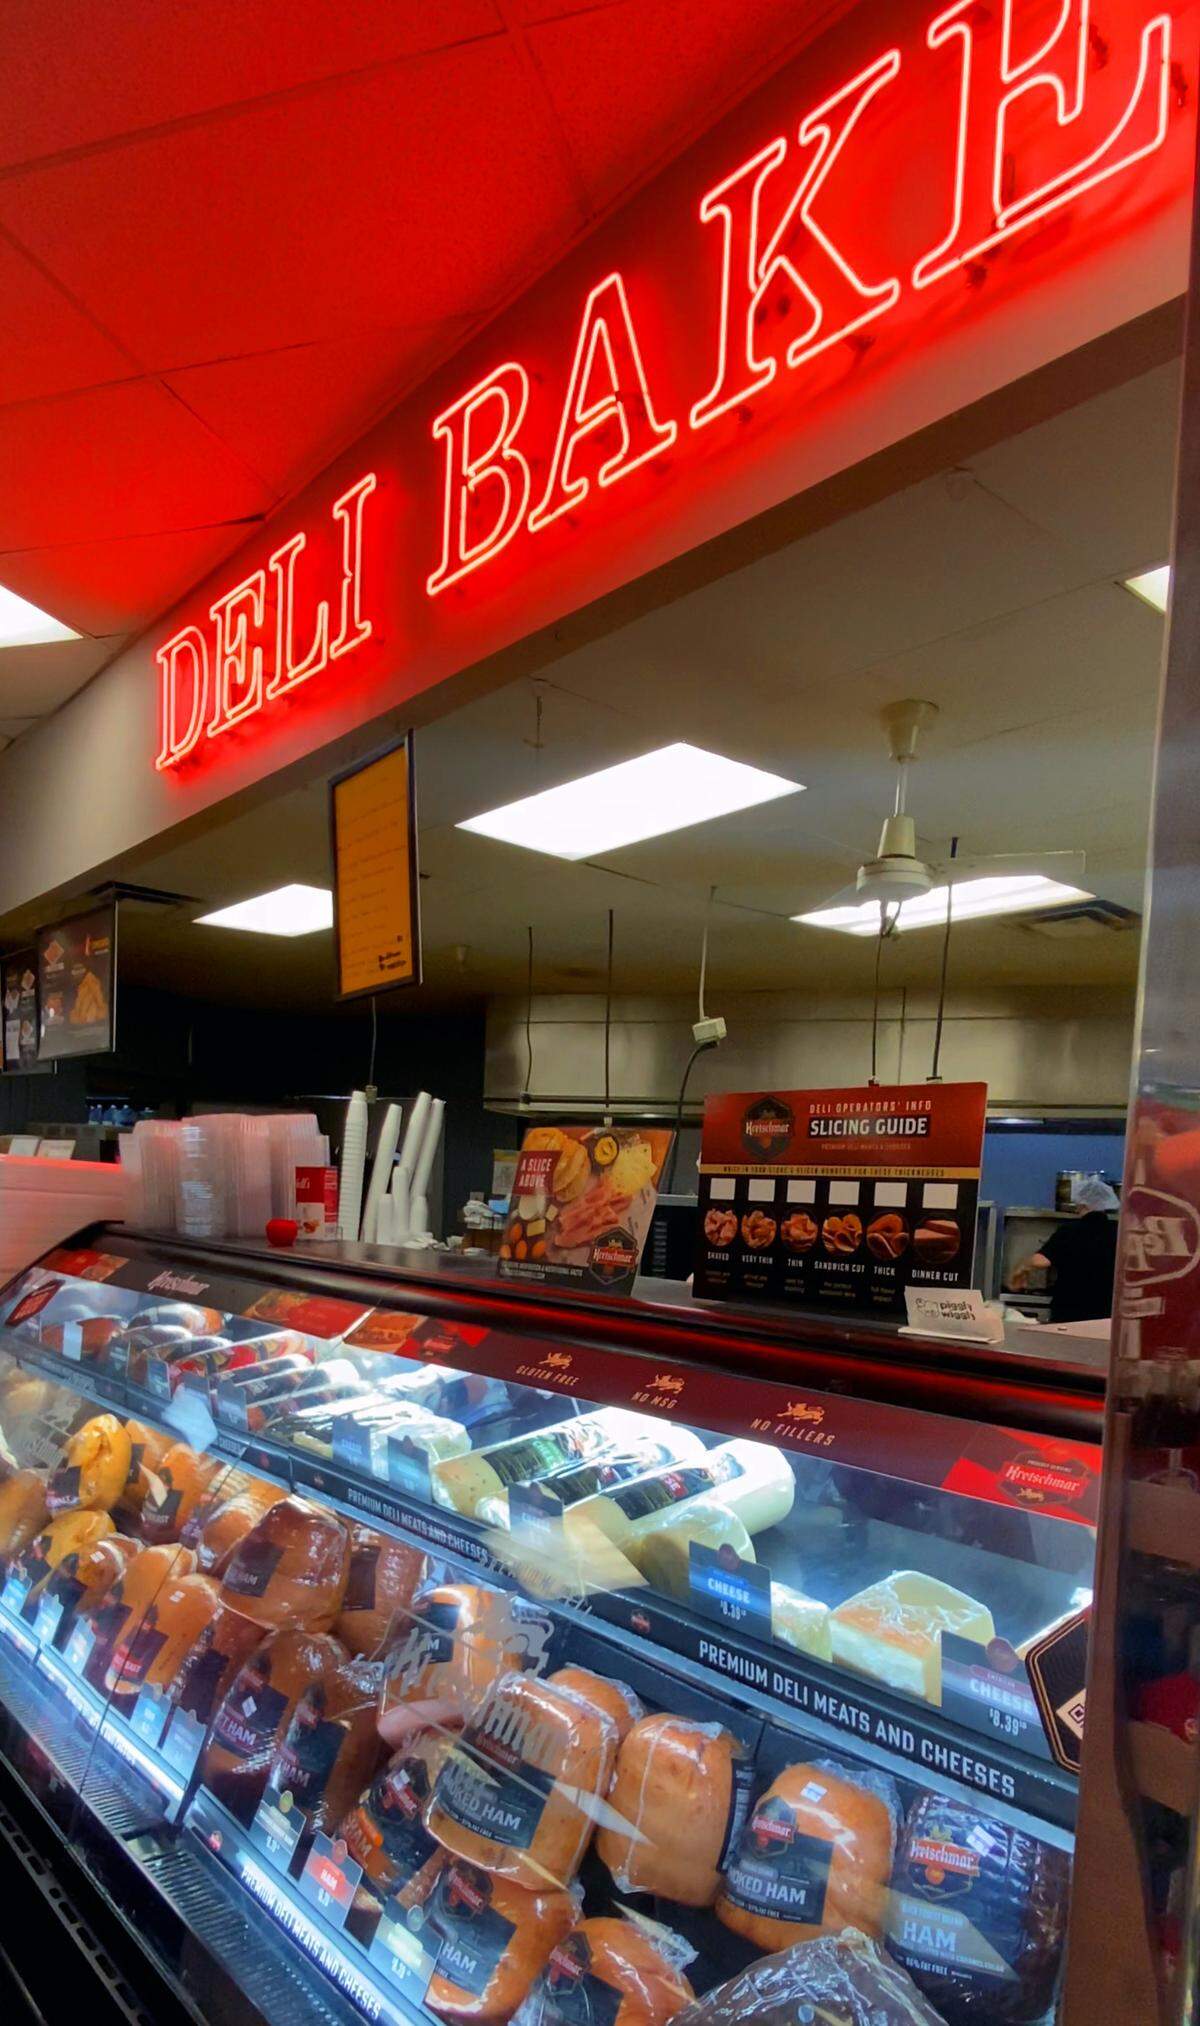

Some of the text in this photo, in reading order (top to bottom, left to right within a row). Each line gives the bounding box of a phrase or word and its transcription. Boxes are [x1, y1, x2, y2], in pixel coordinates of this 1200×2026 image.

[154, 473, 376, 771] DELI
[810, 1103, 831, 1115] DELI
[905, 1100, 932, 1111] INFO
[810, 1118, 928, 1136] SLICING GUIDE
[520, 1158, 552, 1172] A SLICE
[519, 1174, 546, 1188] ABOVE
[708, 1252, 730, 1262] SHAVED
[742, 1254, 774, 1265] VERY THIN
[788, 1258, 803, 1268] THIN
[814, 1260, 866, 1274] SANDWICH CUT
[874, 1266, 896, 1277] THICK
[912, 1270, 959, 1282] DINNER CUT
[940, 1300, 972, 1312] piggly
[942, 1310, 976, 1321] wiggly
[516, 1364, 580, 1387] GLUTEN FREE
[632, 1391, 678, 1410] NO MSG
[751, 1418, 836, 1447] NO FILLERS
[1006, 1465, 1080, 1492] Kretschmar
[348, 1488, 382, 1513] PREMIUM
[382, 1503, 400, 1522] DELI
[401, 1514, 427, 1534] MEATS
[448, 1533, 488, 1562] CHEESES
[707, 1578, 750, 1604] CHEESE
[970, 1678, 1034, 1716] CHEESE
[700, 1640, 1016, 1800] PREMIUM DELI MEATS AND CHEESES
[227, 1722, 257, 1746] HAM
[482, 1804, 522, 1832] HAM
[766, 1882, 806, 1905] HAM
[241, 1865, 382, 2020] PREMIUM DELI MEATS AND CHEESES
[903, 1920, 957, 1952] HAM
[442, 1944, 478, 1974] HAM
